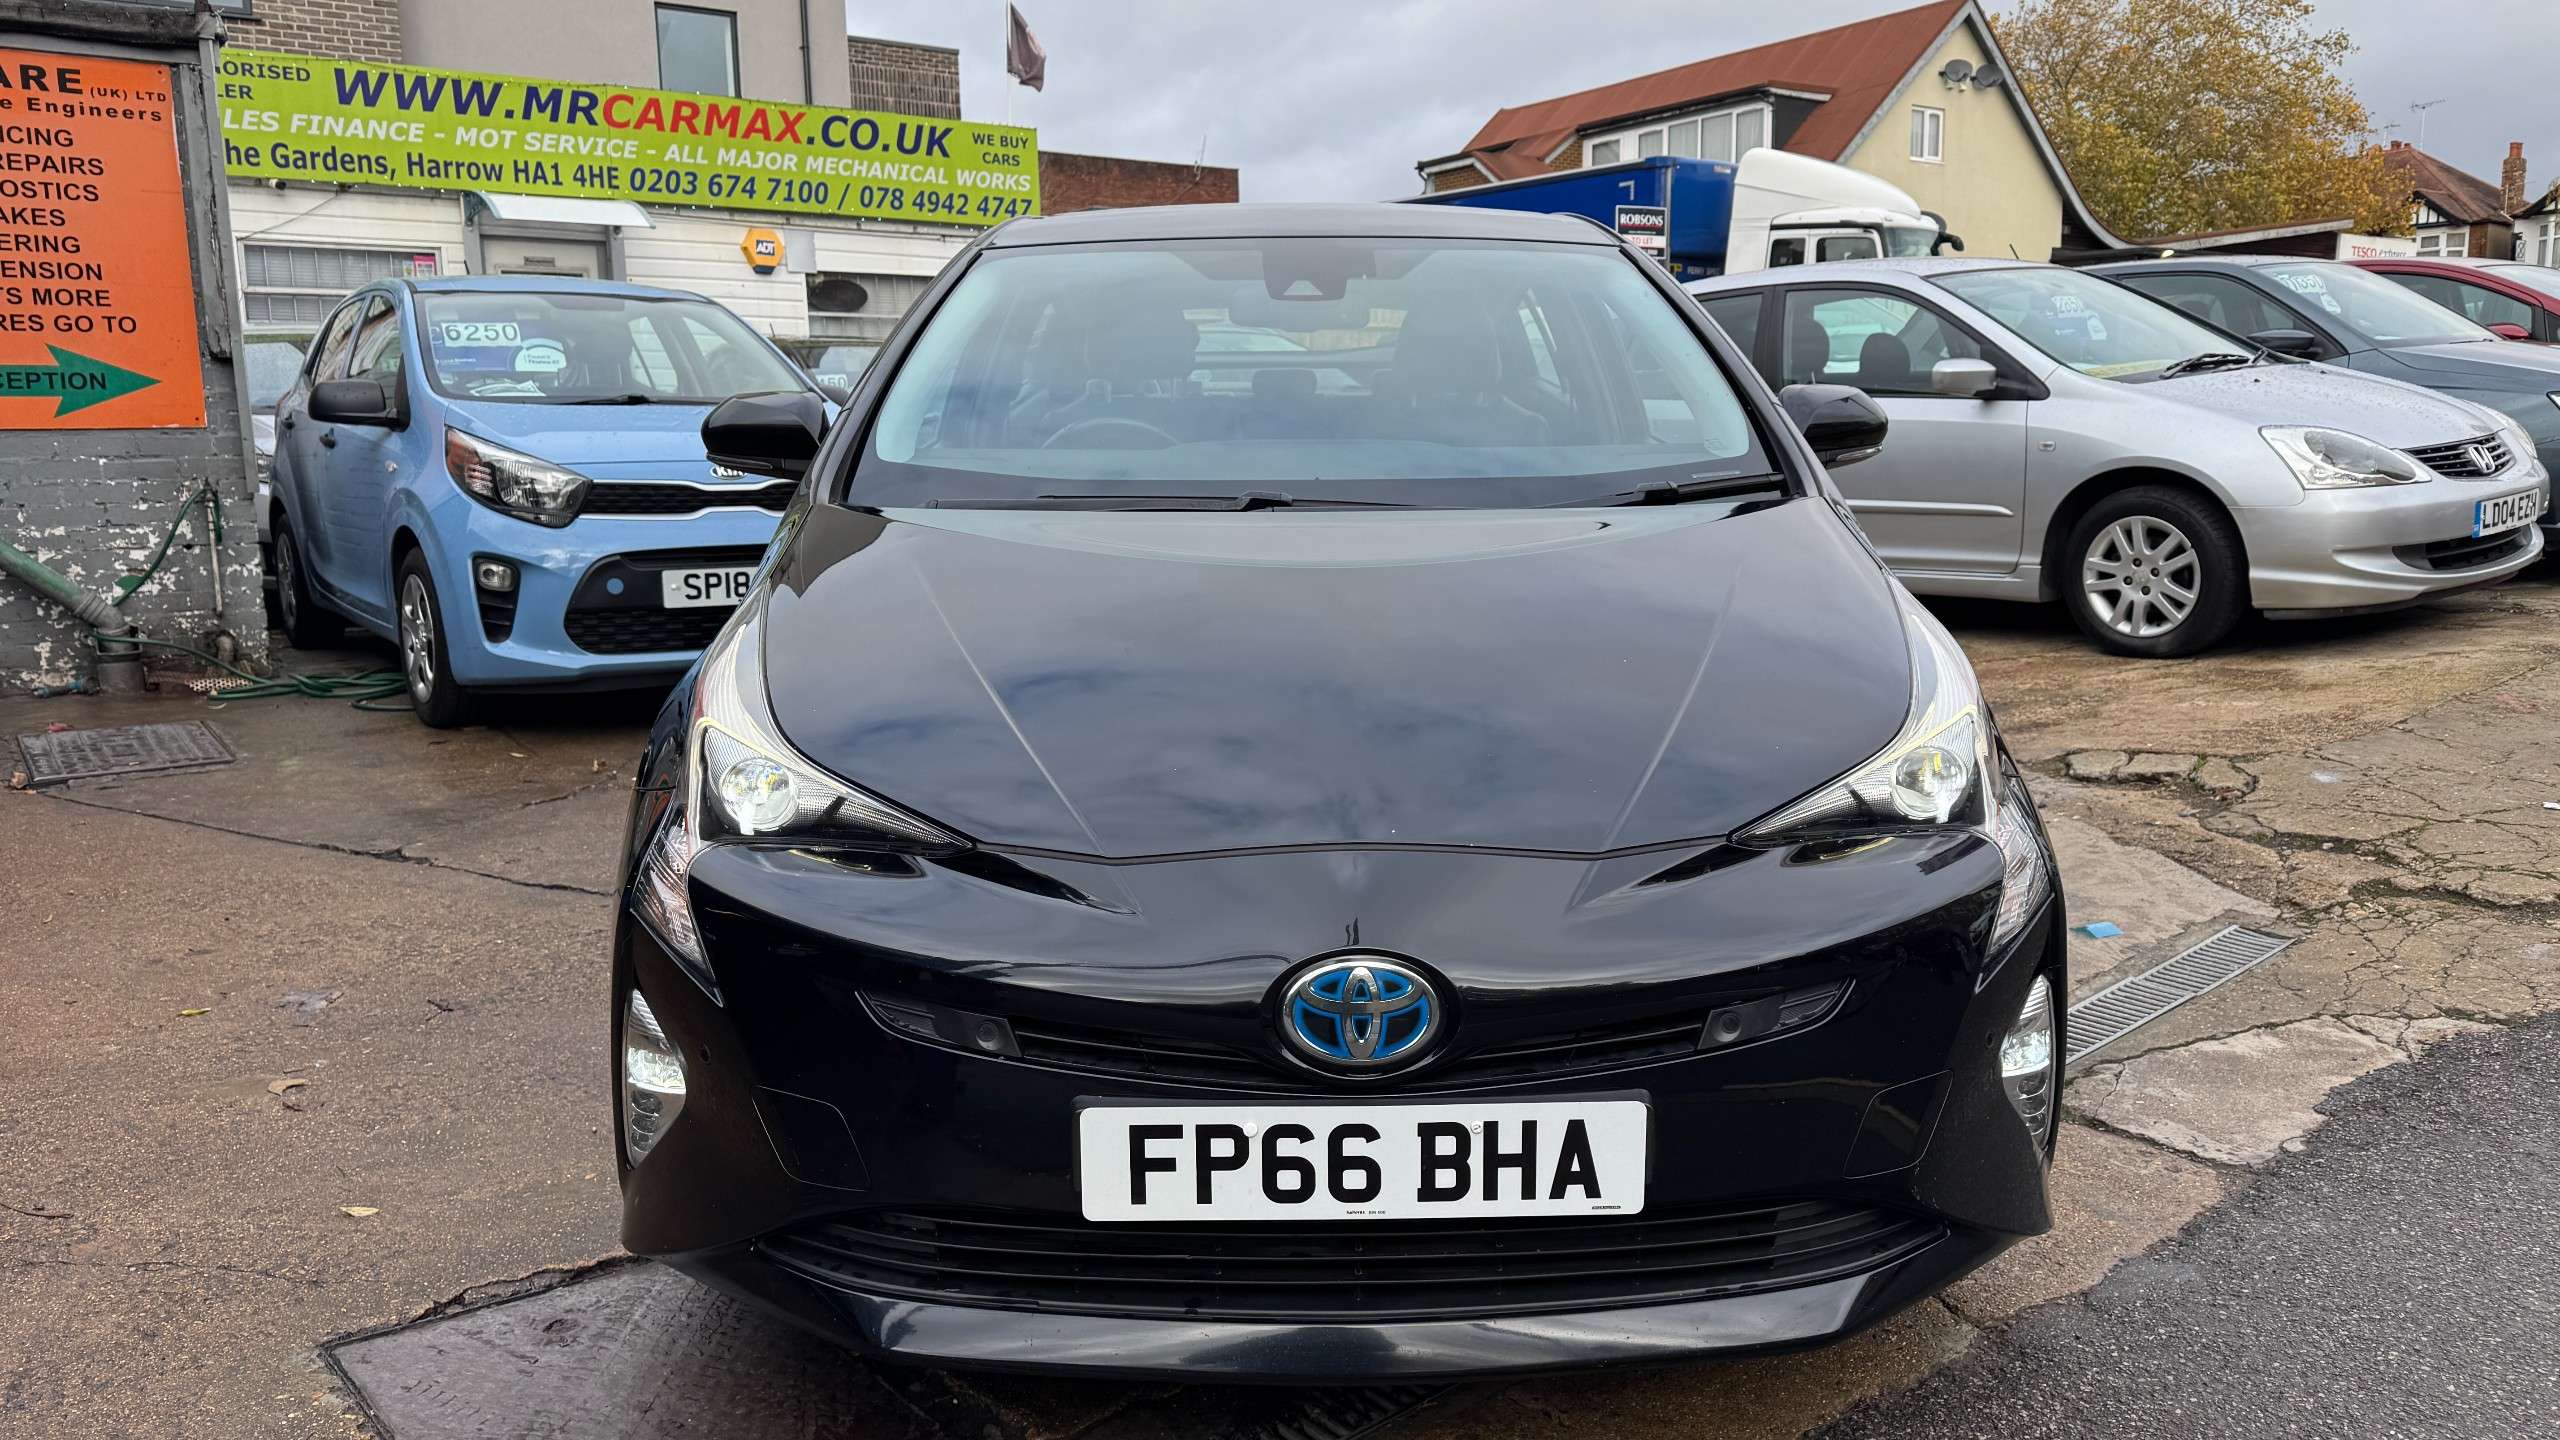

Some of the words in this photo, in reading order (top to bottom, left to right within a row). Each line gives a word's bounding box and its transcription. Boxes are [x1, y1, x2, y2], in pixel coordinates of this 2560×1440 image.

[90, 86, 128, 101] (UK)
[136, 91, 166, 102] LTD
[27, 97, 162, 122] Engineers
[334, 67, 954, 158] WWW.MRCARMAX.CO.UK
[223, 108, 280, 132] LES
[290, 113, 425, 143] FINANCE
[455, 126, 518, 150] MOT
[524, 131, 639, 159] SERVICE
[664, 143, 708, 165] ALL
[717, 147, 798, 172] MAJOR
[806, 156, 948, 184] MECHANICAL
[957, 169, 1031, 192] WORKS
[973, 132, 995, 146] WE
[1000, 136, 1029, 149] BUY
[0, 152, 104, 176] EPAIRS
[982, 152, 1020, 167] CARS
[224, 138, 261, 167] he
[271, 142, 396, 181] Gardens,
[407, 152, 503, 182] Harrow
[513, 159, 564, 186] HA1
[572, 165, 620, 190] 4HE
[629, 168, 698, 195] 0203
[708, 173, 757, 199] 674
[767, 178, 828, 205] 7100
[836, 183, 851, 210] /
[859, 185, 904, 211] 078
[912, 190, 969, 216] 4942
[976, 195, 1032, 217] 4747
[0, 179, 99, 202] OSTICS
[1620, 213, 1663, 225] ROBSONS
[757, 241, 775, 254] ADT
[2351, 246, 2377, 258] TESCO
[0, 260, 103, 281] ENSION
[0, 286, 22, 305] S
[32, 287, 112, 307] MORE
[53, 314, 94, 333] GO
[101, 315, 137, 333] TO
[445, 324, 518, 341] 6250
[0, 372, 107, 390] EPTION
[2483, 498, 2515, 529] LD04
[2517, 491, 2538, 520] EZH
[683, 572, 750, 600] SP18
[1128, 1123, 1381, 1205] FP66
[1417, 1119, 1602, 1202] BHA
